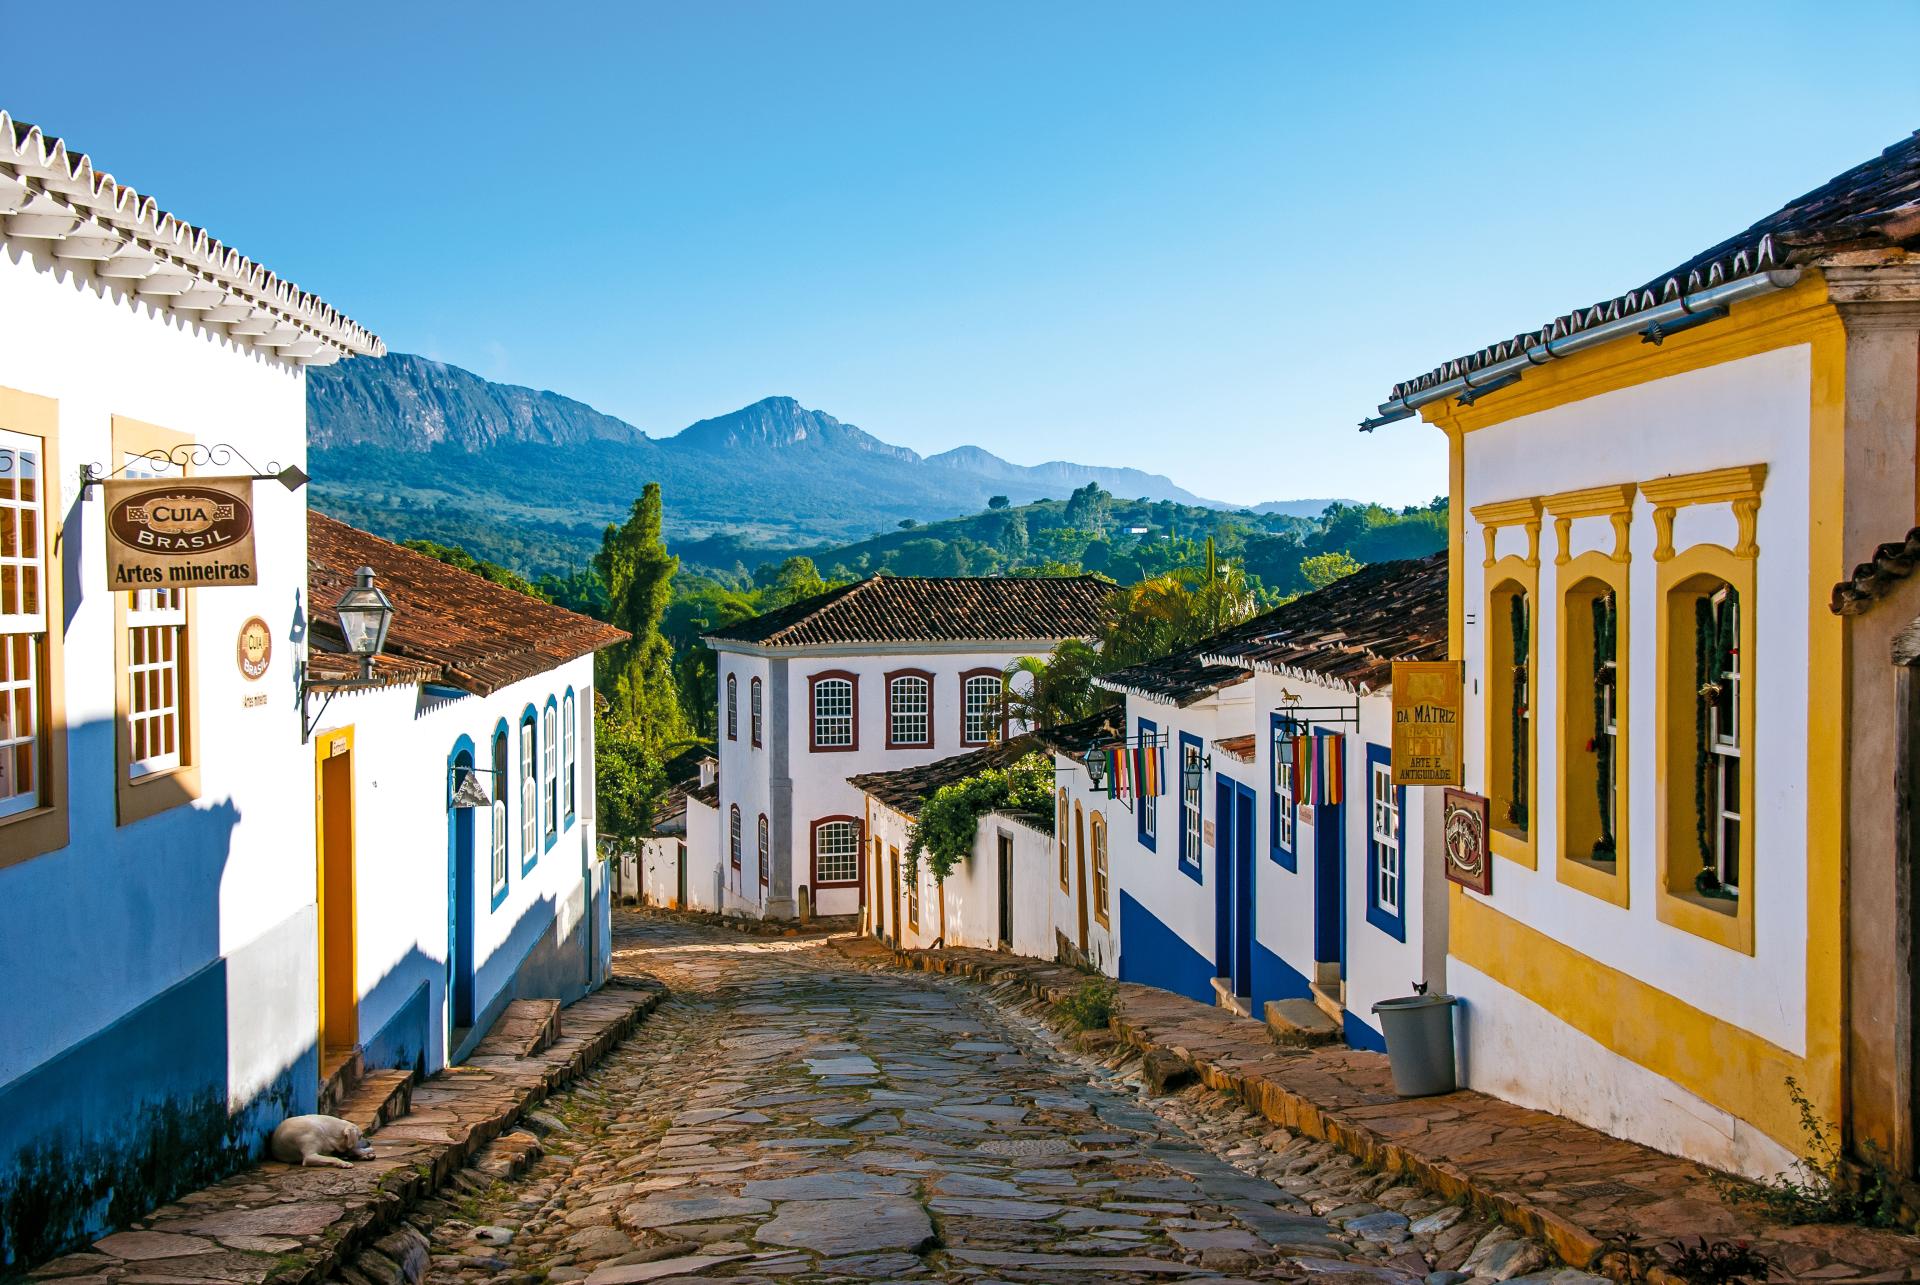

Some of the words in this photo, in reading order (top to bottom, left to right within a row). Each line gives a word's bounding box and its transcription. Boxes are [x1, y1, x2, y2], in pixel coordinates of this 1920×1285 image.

[152, 506, 208, 522] CUIA
[137, 530, 231, 549] BRASIL
[116, 563, 163, 583] Artes
[169, 560, 250, 582] mineiras
[243, 657, 269, 676] BRASIL
[1397, 709, 1409, 722] DA
[1415, 704, 1455, 723] MATRIZ
[1435, 757, 1441, 767] E
[1400, 769, 1451, 779] ANTIGUIDADE
